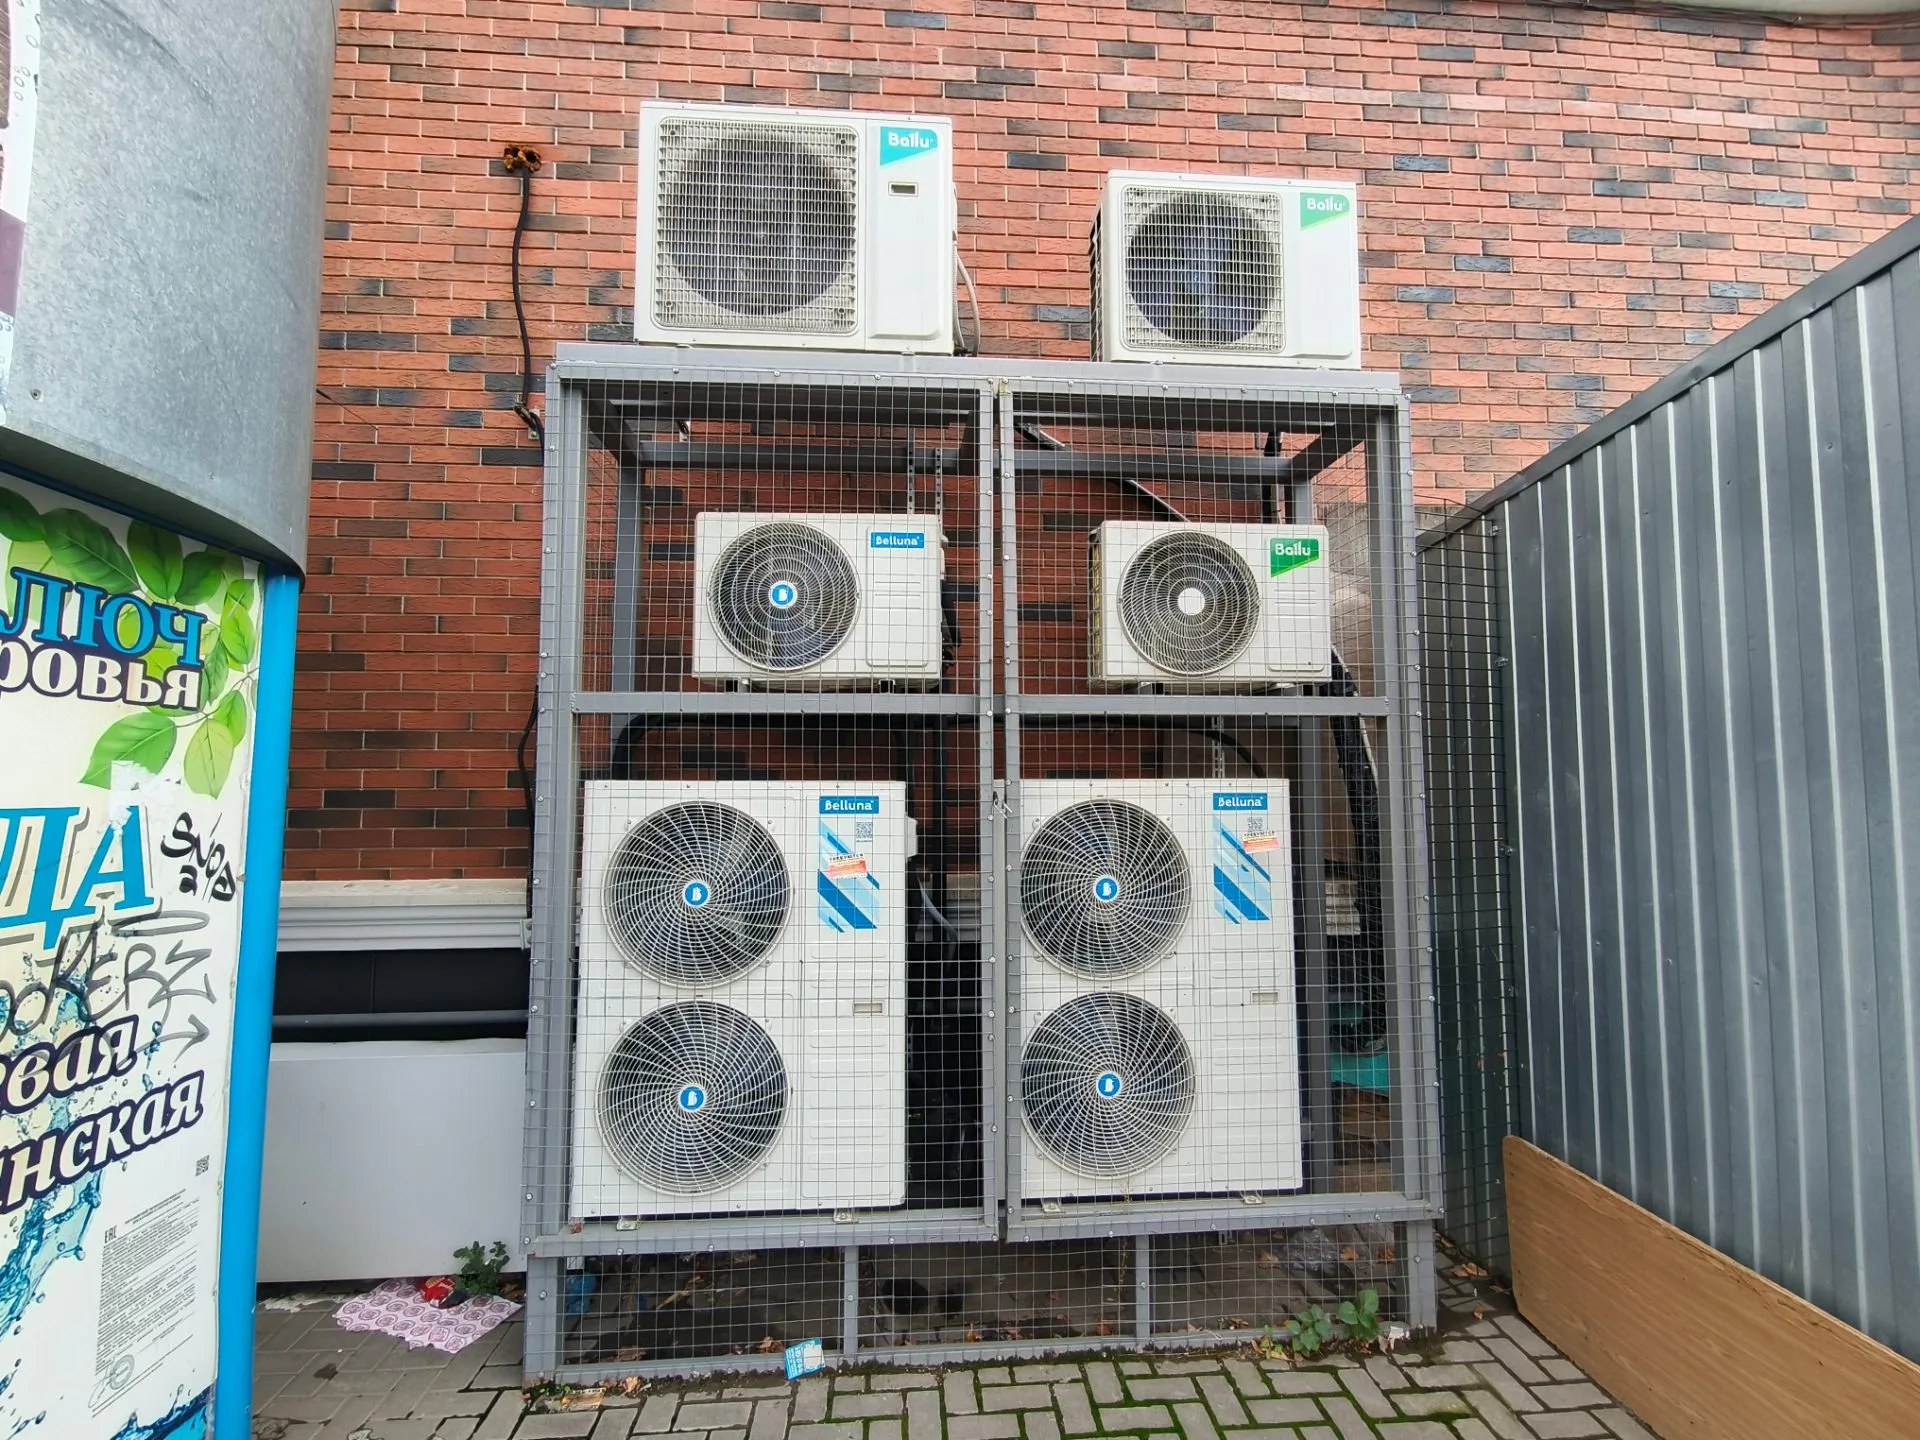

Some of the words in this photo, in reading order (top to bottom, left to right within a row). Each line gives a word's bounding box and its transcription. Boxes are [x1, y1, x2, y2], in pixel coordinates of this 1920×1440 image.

[888, 131, 931, 148] Ballu
[1306, 196, 1343, 212] Ballu
[875, 535, 919, 546] Belluna
[1274, 541, 1311, 556] Ballu
[824, 800, 874, 811] Belluna
[1217, 797, 1263, 807] Belluna
[0, 1016, 138, 1112] вая
[0, 1071, 204, 1212] нская
